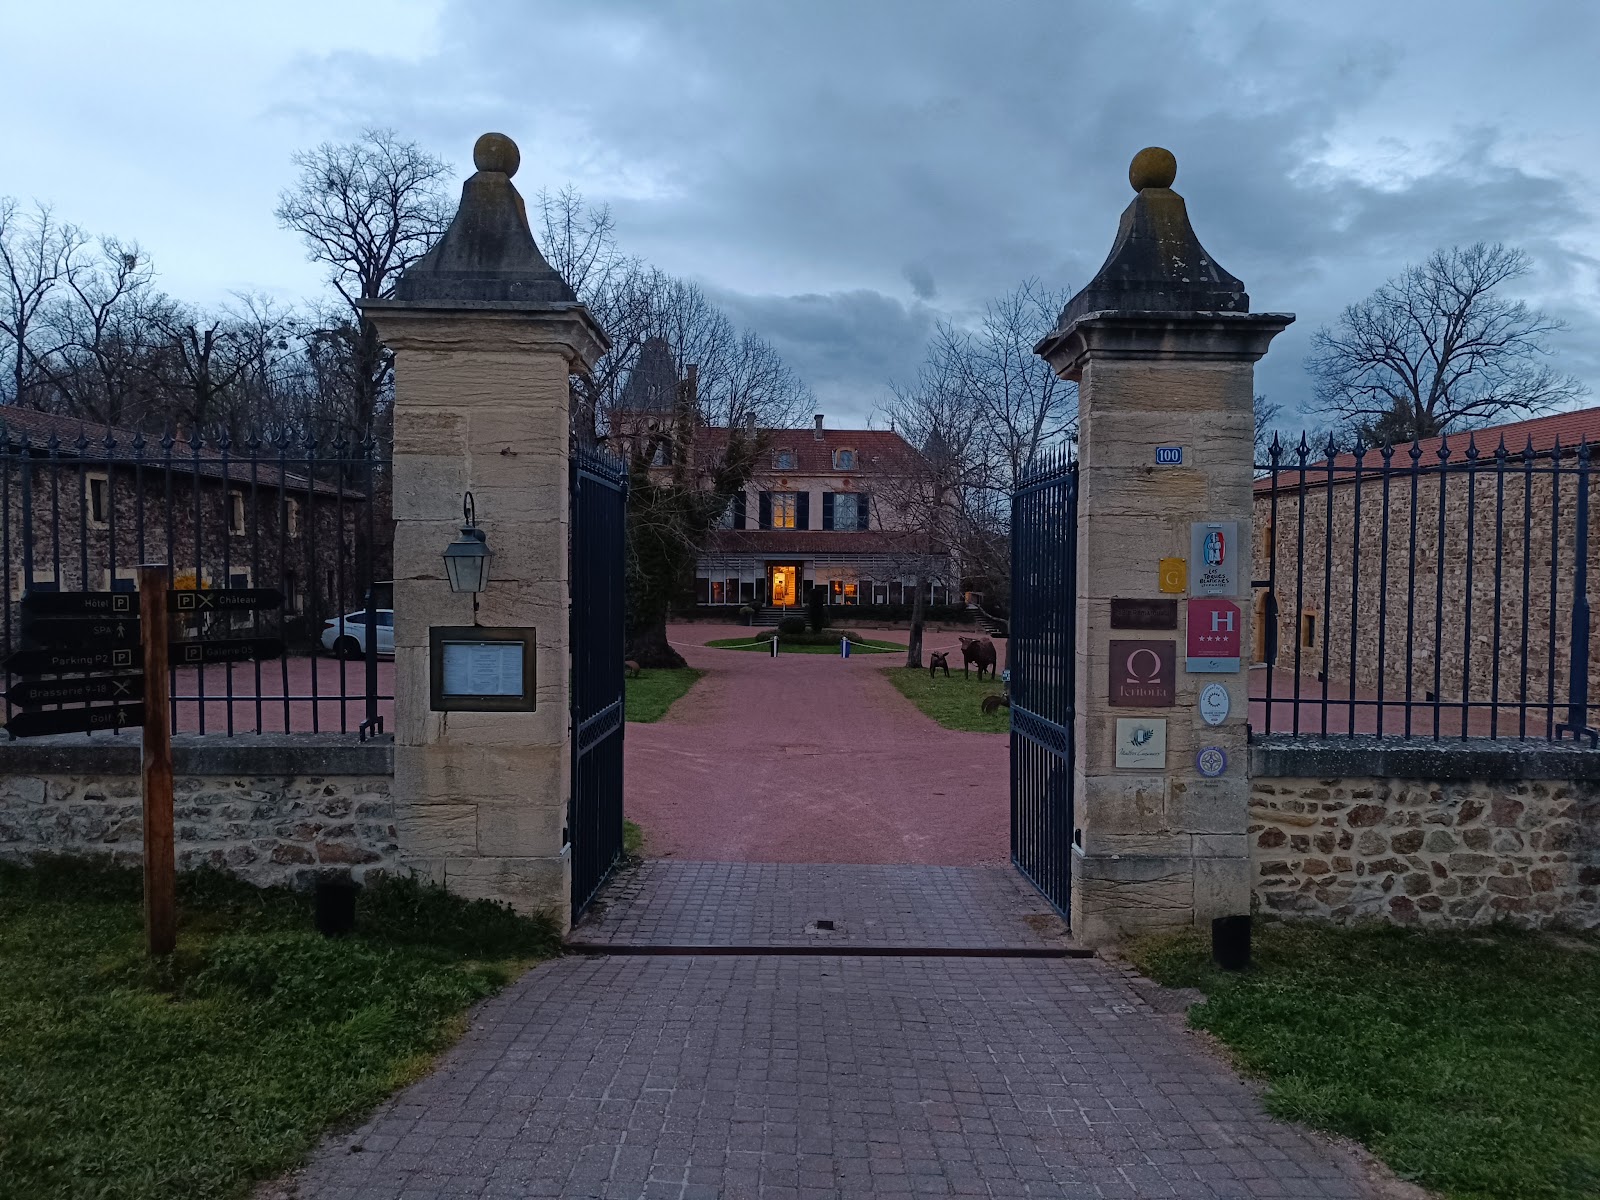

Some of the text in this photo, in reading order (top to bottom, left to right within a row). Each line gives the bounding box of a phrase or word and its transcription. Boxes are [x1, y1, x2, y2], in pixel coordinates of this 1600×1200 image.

[1159, 449, 1179, 462] 100
[1166, 571, 1178, 585] G
[84, 599, 109, 608] Hôtel
[219, 595, 257, 605] Château
[1210, 611, 1235, 632] H
[93, 626, 112, 635] SPA
[51, 656, 93, 666] Parking
[95, 654, 108, 663] P2
[29, 684, 107, 698] Brasserie 9-18
[90, 713, 112, 723] Golf
